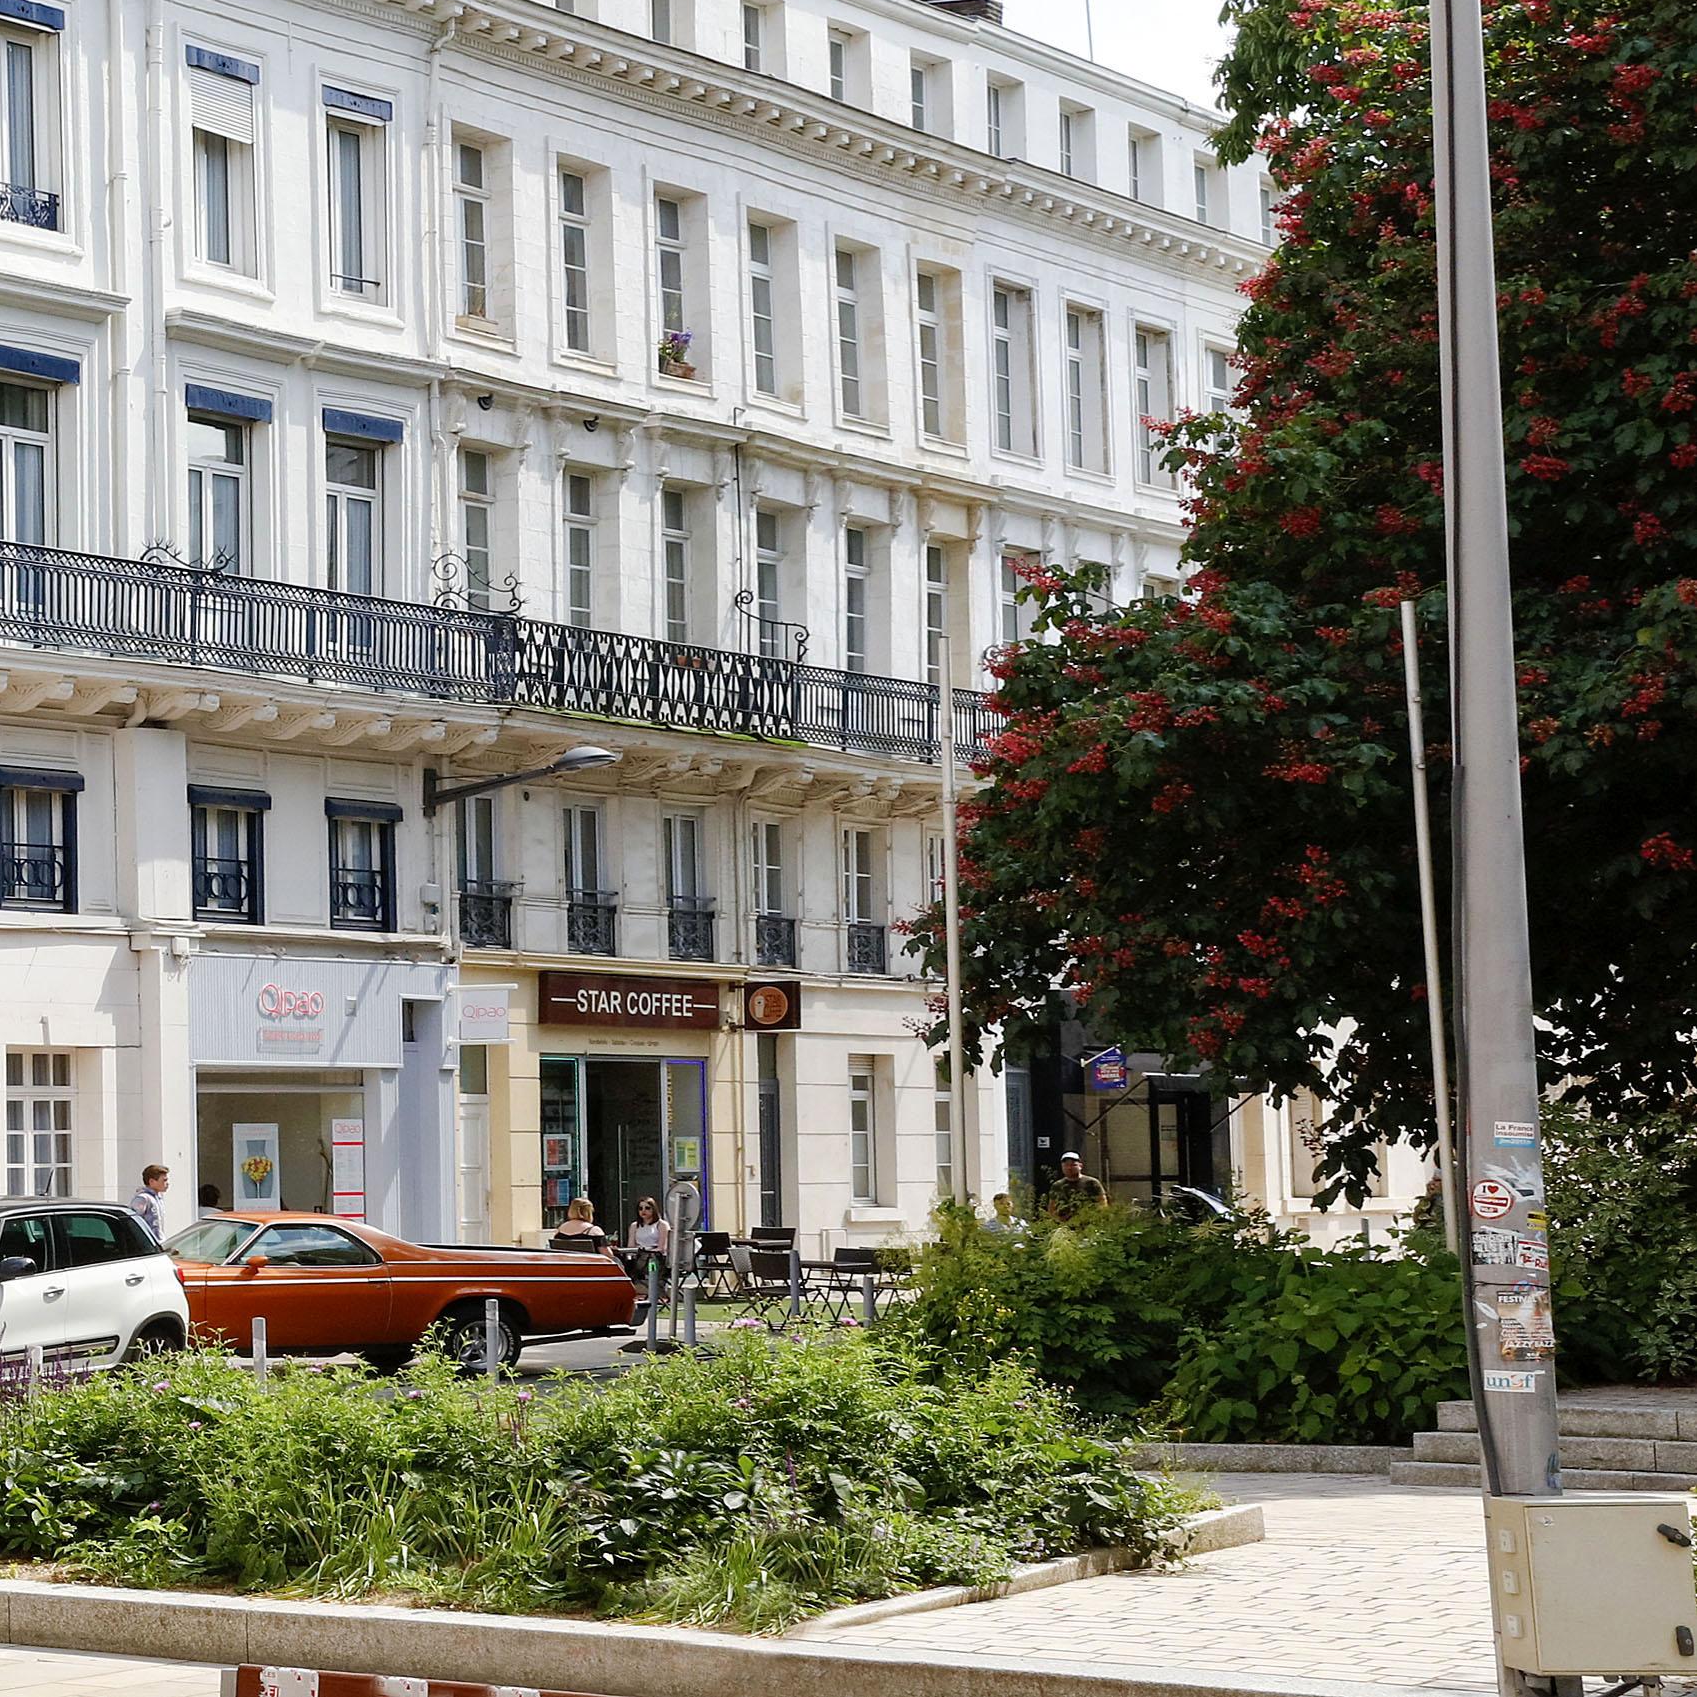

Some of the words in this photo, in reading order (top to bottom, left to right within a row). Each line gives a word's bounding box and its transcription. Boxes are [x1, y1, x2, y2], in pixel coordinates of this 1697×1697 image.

[577, 989, 622, 1014] STAR
[627, 992, 693, 1017] COFFEE
[1482, 1185, 1487, 1194] I
